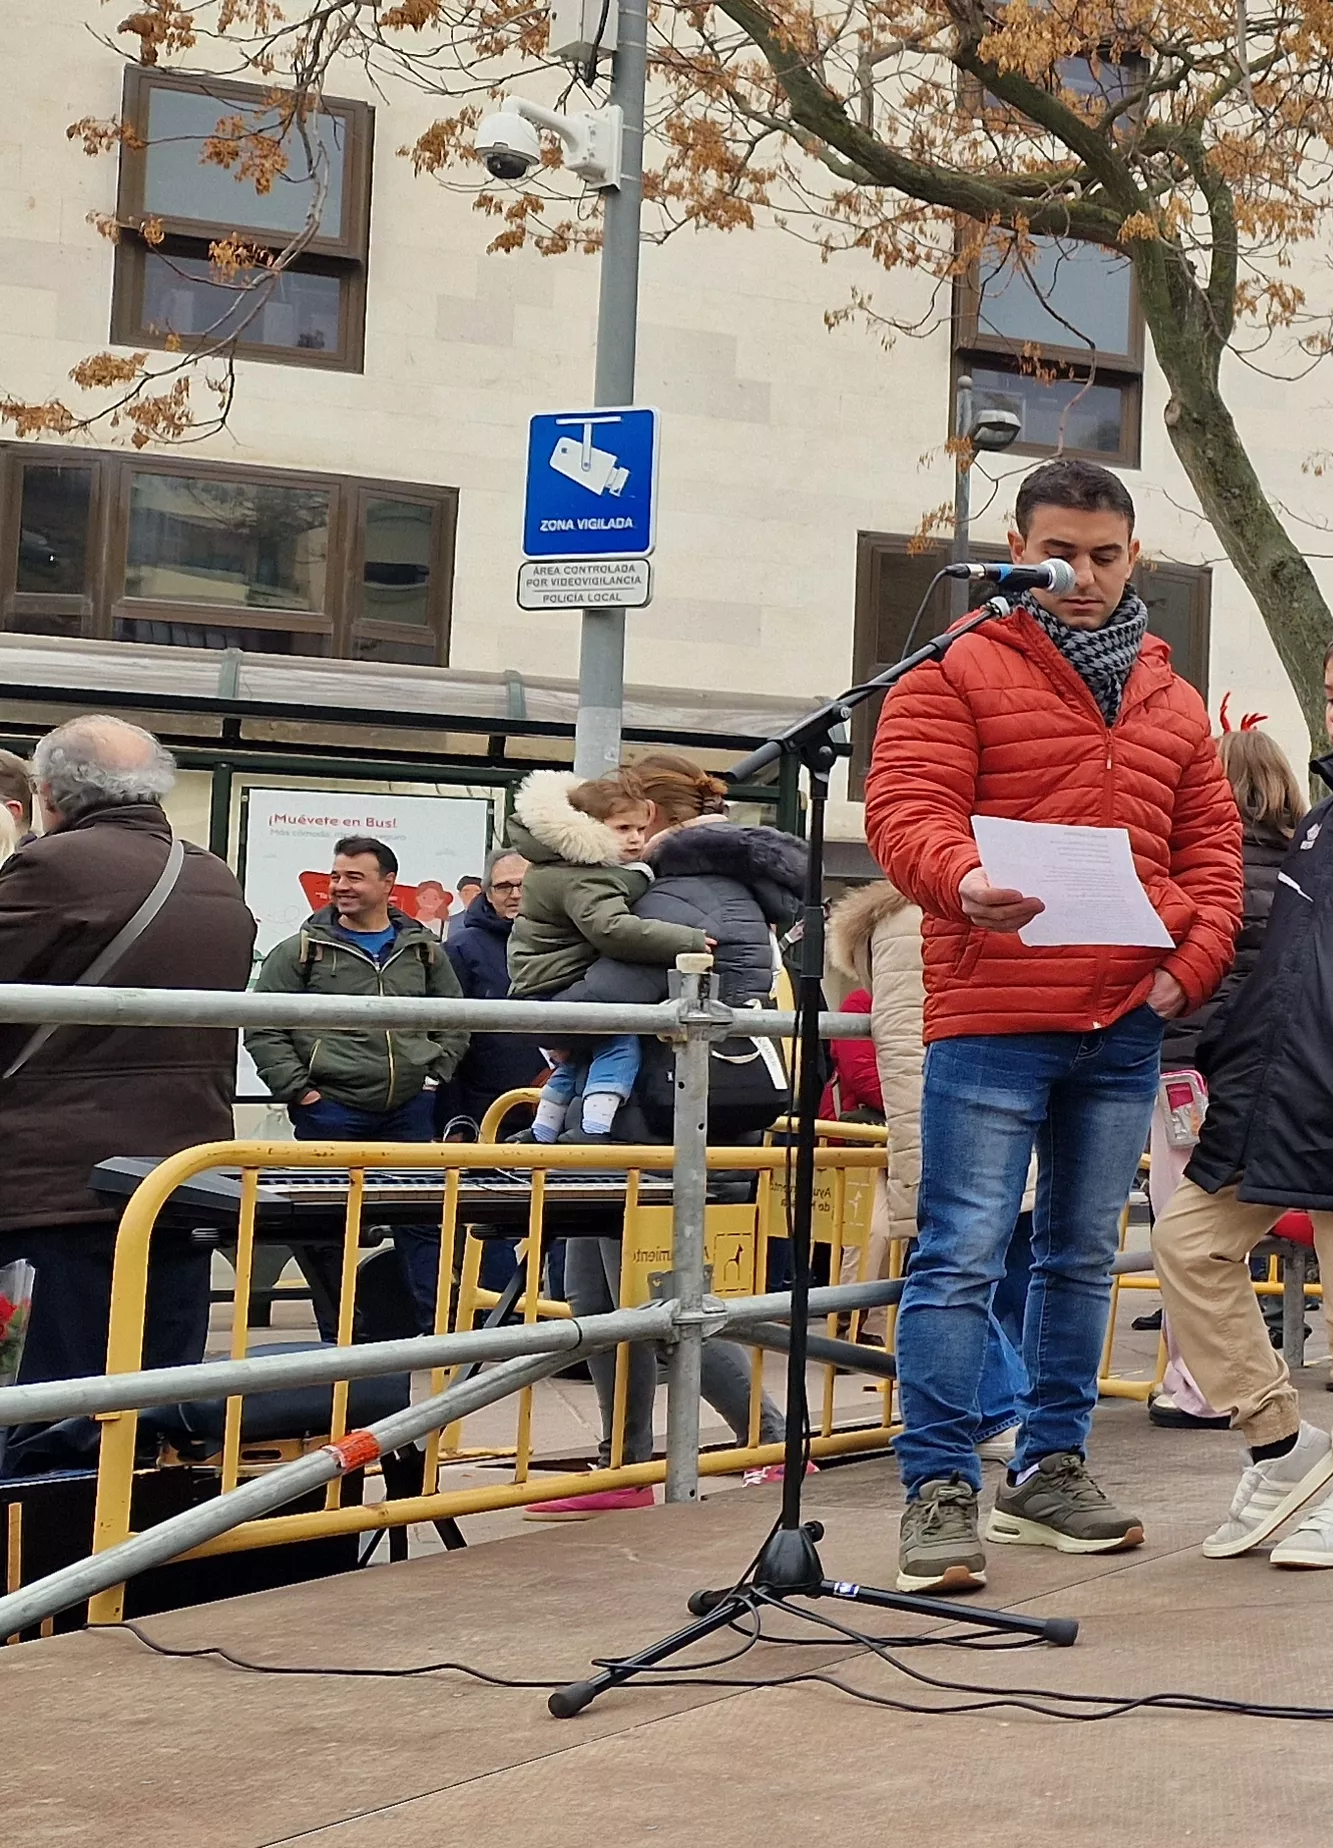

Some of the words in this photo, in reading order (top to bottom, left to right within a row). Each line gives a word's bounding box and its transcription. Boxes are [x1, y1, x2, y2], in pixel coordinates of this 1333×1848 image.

[540, 519, 575, 531] ZONA
[577, 517, 634, 530] VIGILADA
[533, 565, 560, 576] ÁREA
[563, 564, 635, 575] CONTROLADA
[526, 578, 548, 587] POR
[550, 575, 641, 587] VIDEOVIGILANCIA
[542, 593, 583, 603] POLICÍA
[587, 592, 622, 602] LOCAL
[268, 813, 338, 827] ¡Muévete
[343, 818, 361, 826] en
[366, 817, 397, 829] Bus!
